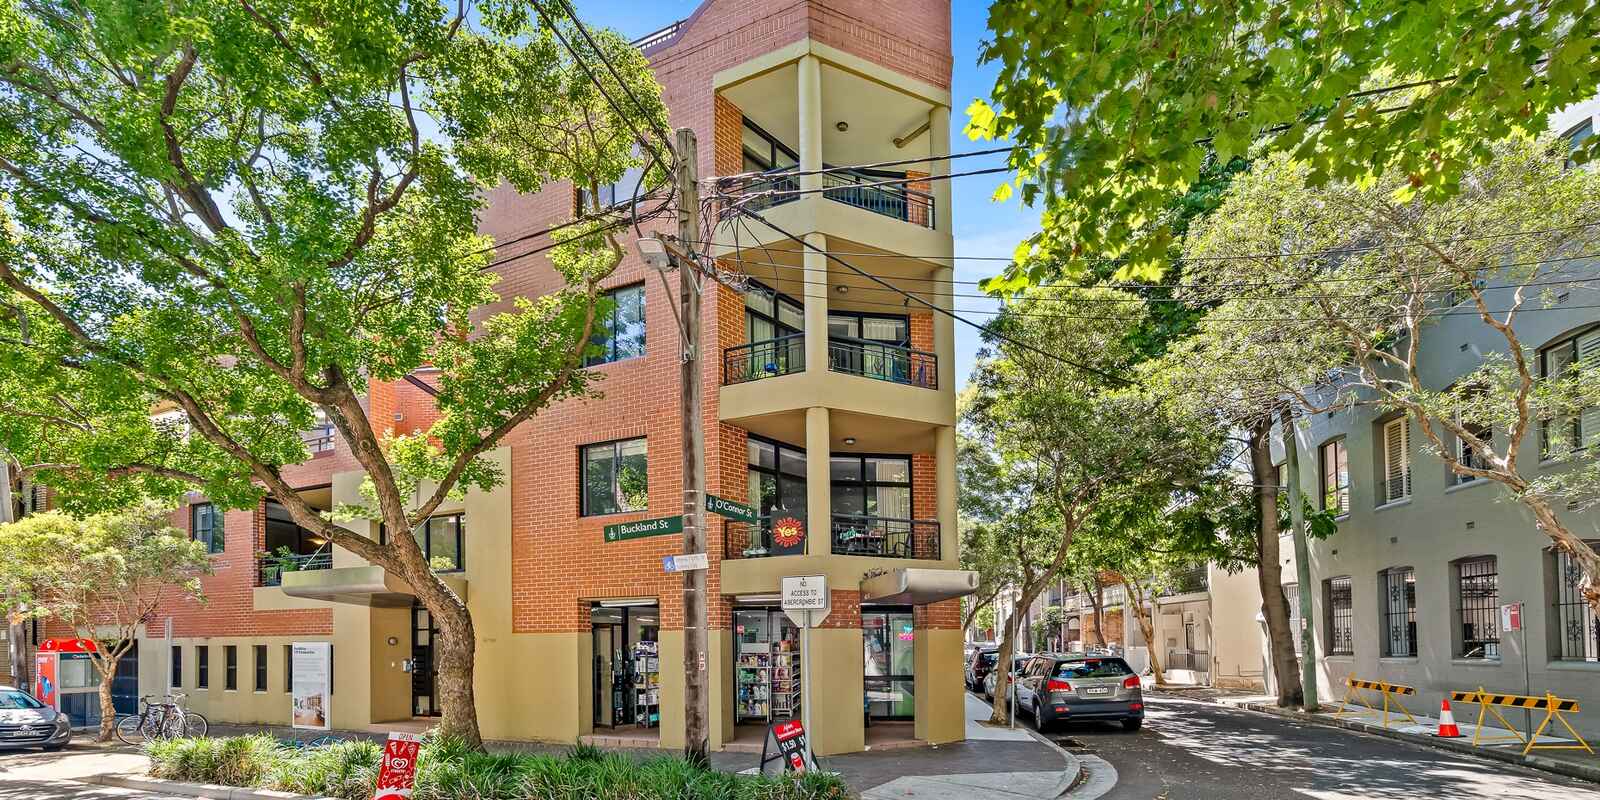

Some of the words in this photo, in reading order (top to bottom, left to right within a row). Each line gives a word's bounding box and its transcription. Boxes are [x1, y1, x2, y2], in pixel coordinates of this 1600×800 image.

[715, 500, 745, 515] O'Connor
[746, 508, 753, 518] St
[621, 521, 657, 534] Buckland
[659, 520, 669, 529] St
[778, 526, 797, 537] Yes
[791, 589, 809, 597] ACCESS
[400, 733, 414, 741] OPEN
